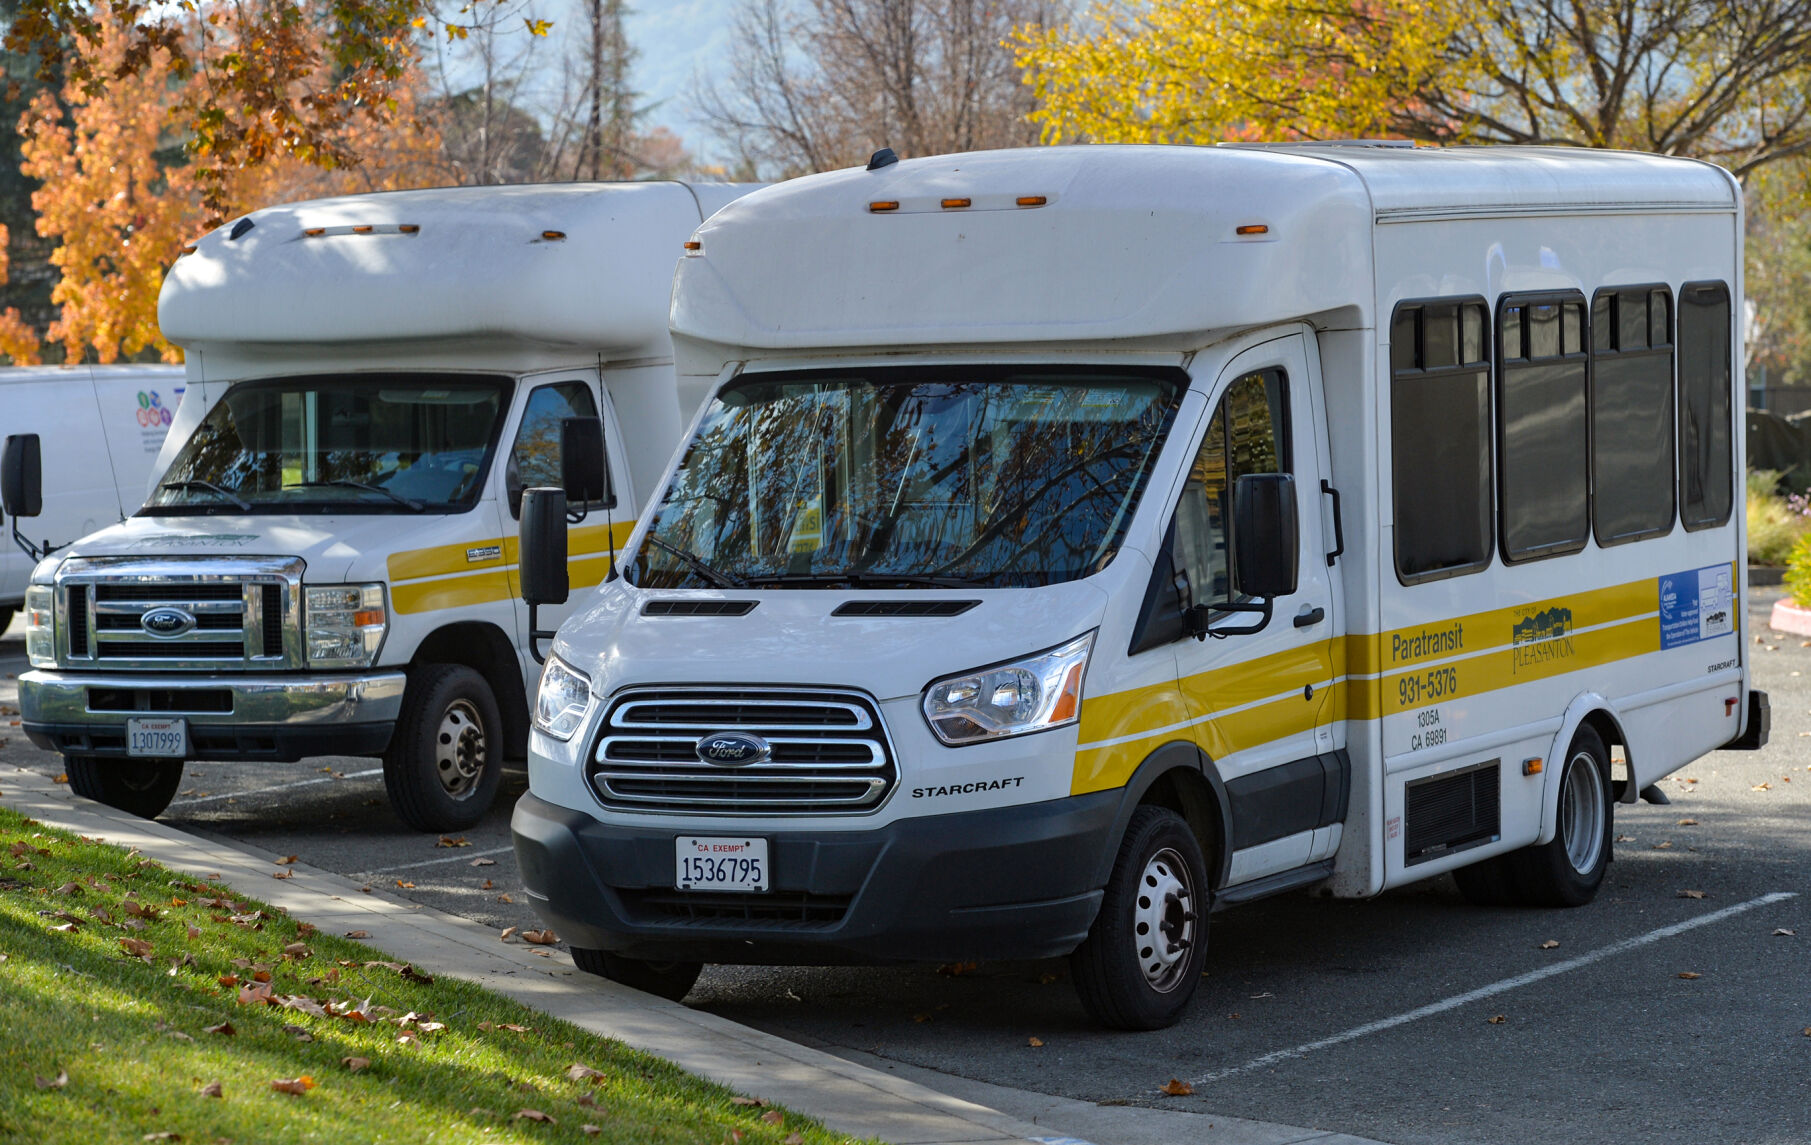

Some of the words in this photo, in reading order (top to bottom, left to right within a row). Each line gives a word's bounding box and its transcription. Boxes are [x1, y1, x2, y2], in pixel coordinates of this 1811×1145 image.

[152, 615, 177, 628] Ford
[1392, 622, 1464, 662] Paratransit
[1512, 636, 1575, 676] PLEASANTON
[1707, 658, 1736, 673] STARCRAFT
[1399, 667, 1457, 706] 931-5376
[1417, 708, 1440, 729] 1305A
[132, 732, 181, 750] 1307999
[708, 739, 746, 758] Ford
[1410, 733, 1423, 751] CA
[1425, 728, 1447, 747] 69891
[911, 776, 1025, 799] STARCRAFT
[697, 844, 709, 852] CA
[713, 844, 745, 853] EXEMPT
[682, 857, 762, 883] 1536795
